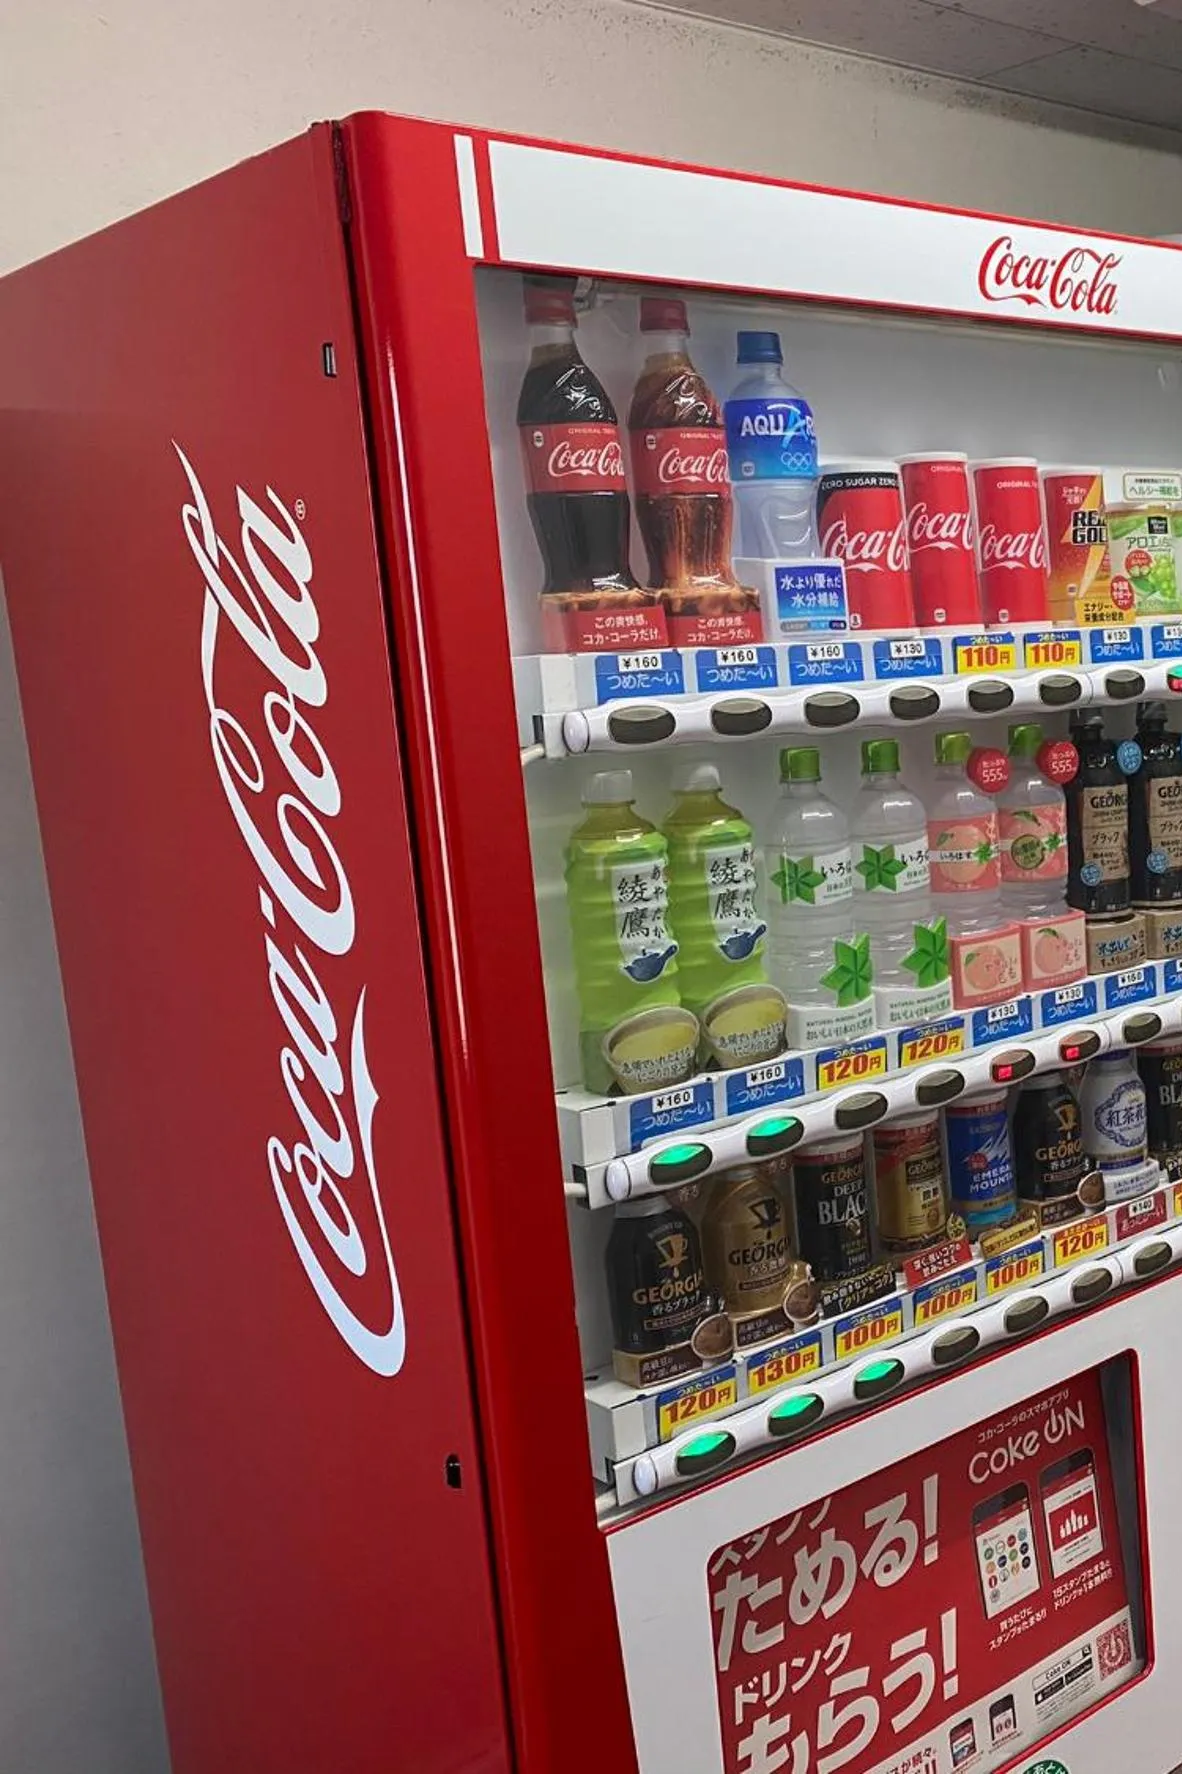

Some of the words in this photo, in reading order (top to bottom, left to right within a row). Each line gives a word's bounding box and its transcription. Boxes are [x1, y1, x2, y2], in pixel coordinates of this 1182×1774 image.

[978, 236, 1123, 315] Coca-Cola
[845, 477, 877, 488] SUGAR
[781, 572, 841, 591] 水より優れた
[791, 593, 839, 609] 水分補給
[894, 643, 922, 655] ¥130
[1107, 631, 1127, 641] ¥130
[622, 657, 658, 669] ¥160
[720, 651, 754, 662] ¥160
[810, 646, 840, 657] ¥160
[963, 646, 1012, 668] 110円
[1031, 643, 1075, 663] 110円
[710, 857, 740, 920] 綾鷹
[172, 438, 406, 1378] Coca-Cola
[618, 874, 650, 938] 綾鷹
[906, 1034, 960, 1060] 120円
[750, 1066, 782, 1082] ¥160
[823, 1052, 882, 1084] 120円
[656, 1091, 691, 1108] ¥160
[1106, 1104, 1144, 1127] 紅茶花
[818, 1192, 867, 1226] BLAC
[1059, 1232, 1104, 1258] 120円
[991, 1258, 1039, 1289] 100円
[920, 1288, 972, 1319] 100円
[841, 1317, 897, 1351] 100円
[753, 1352, 815, 1387] 130円
[666, 1387, 731, 1424] 120円
[978, 1389, 1069, 1443] コカ・コーラのスマホアプリ
[968, 1430, 1040, 1484] Coke
[1044, 1400, 1085, 1444] ON
[713, 1474, 940, 1671] ためる!
[999, 1606, 1033, 1632] 買うたびに
[734, 1631, 852, 1726] ドリンク
[1046, 1666, 1061, 1681] Coke
